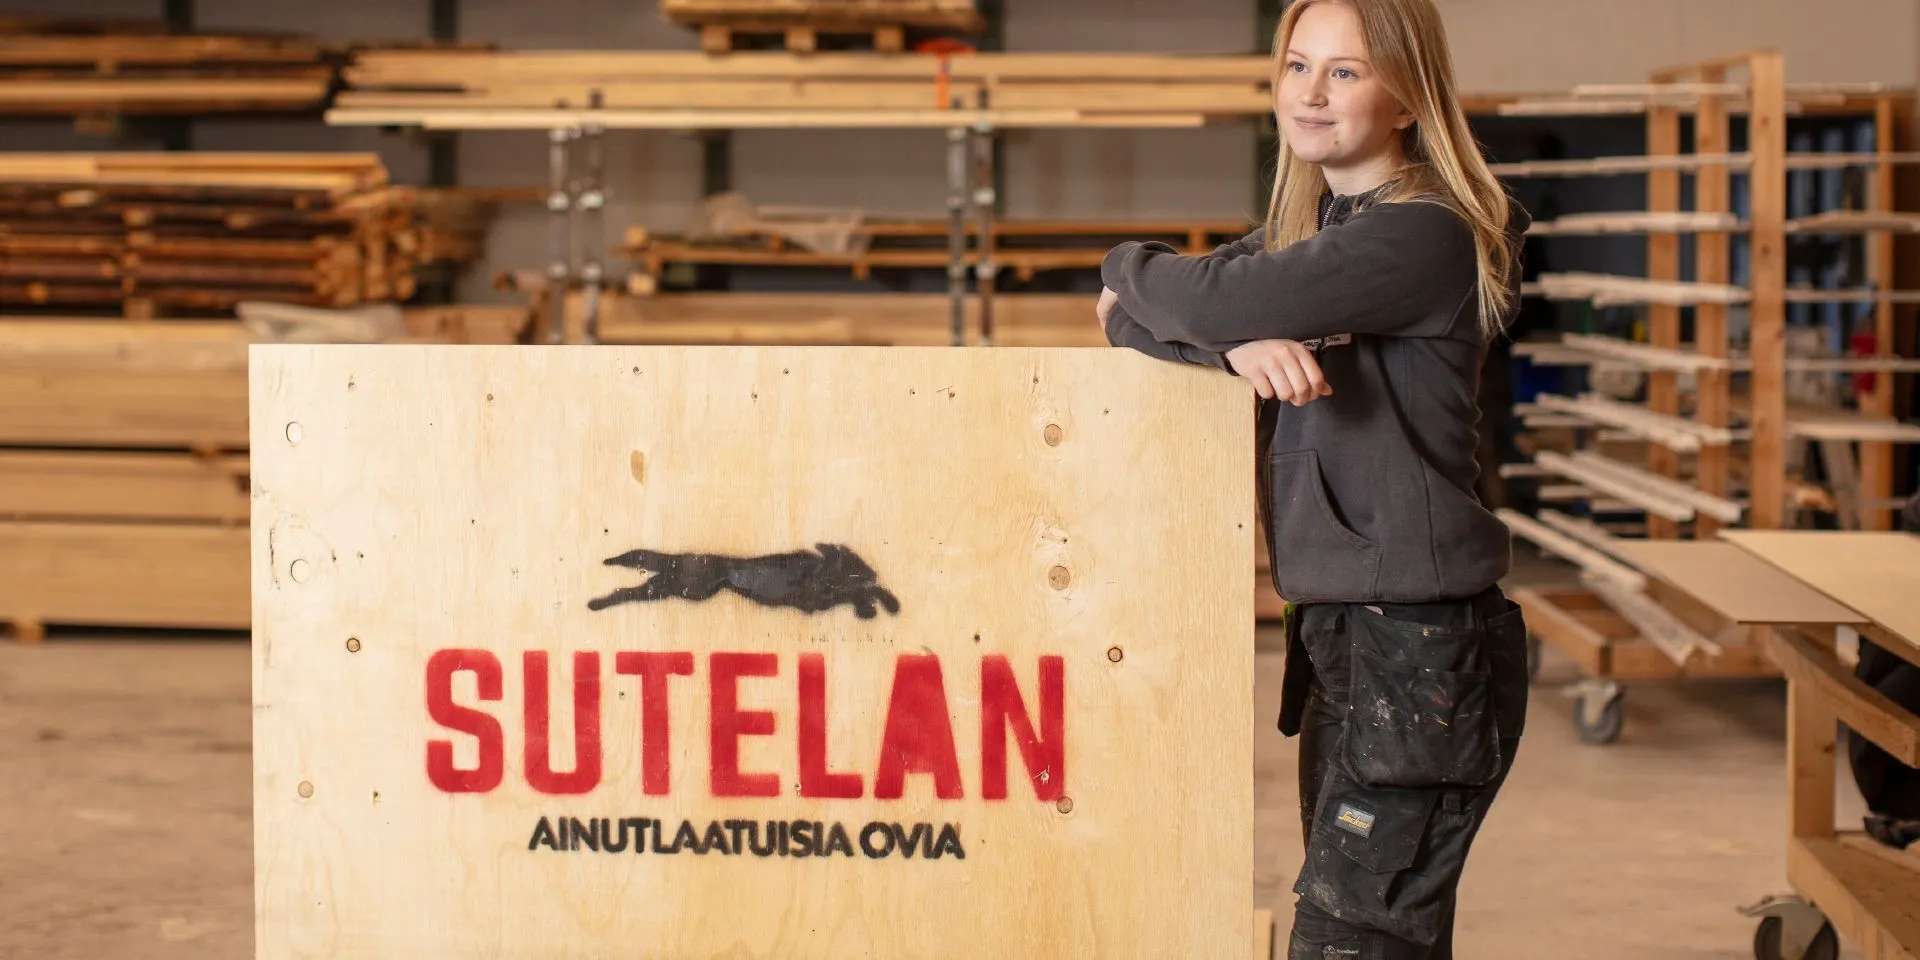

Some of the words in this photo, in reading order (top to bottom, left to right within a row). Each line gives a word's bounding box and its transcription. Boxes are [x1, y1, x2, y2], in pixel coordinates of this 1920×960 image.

[425, 648, 1066, 802] SUTELAN
[528, 816, 854, 858] AINUTLAATUISIA
[859, 821, 966, 860] OVIA
